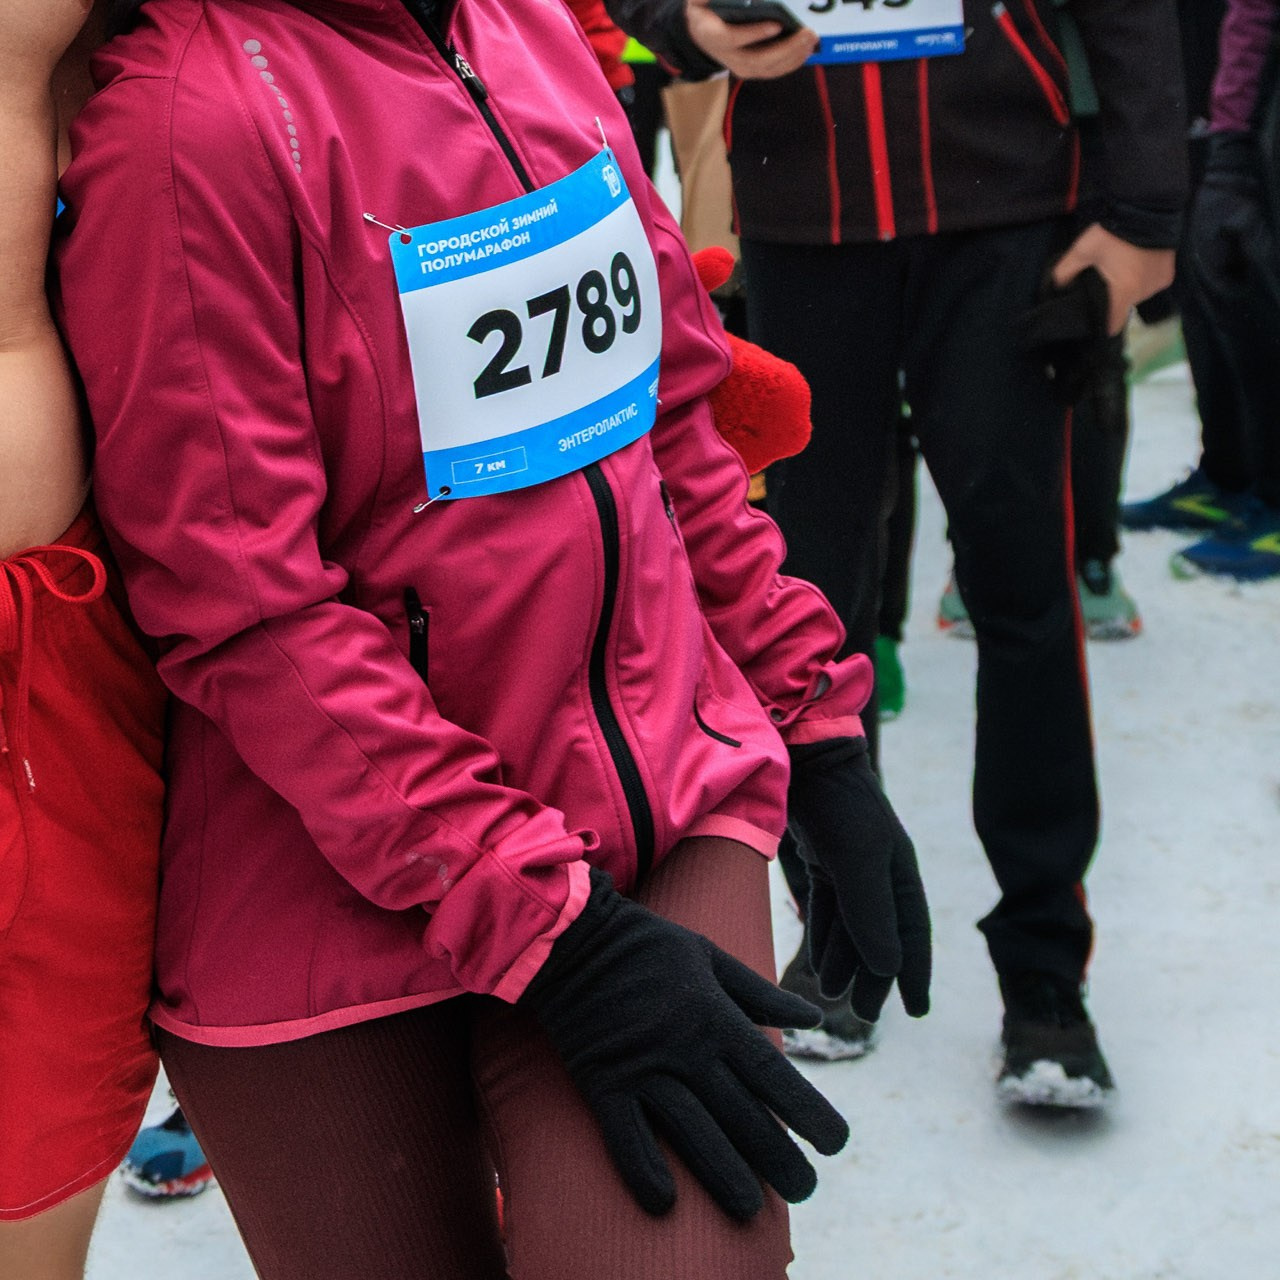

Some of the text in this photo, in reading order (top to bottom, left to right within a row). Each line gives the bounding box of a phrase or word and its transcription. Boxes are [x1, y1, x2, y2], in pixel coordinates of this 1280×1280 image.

[417, 198, 559, 257] ГОРОДСКОЙ ЗИМНИЙ
[420, 231, 531, 274] ПОЛУМАРАФОН
[466, 251, 643, 400] 2789
[557, 402, 639, 453] ЭНТЕРОЛАКТИС
[474, 463, 484, 475] 7
